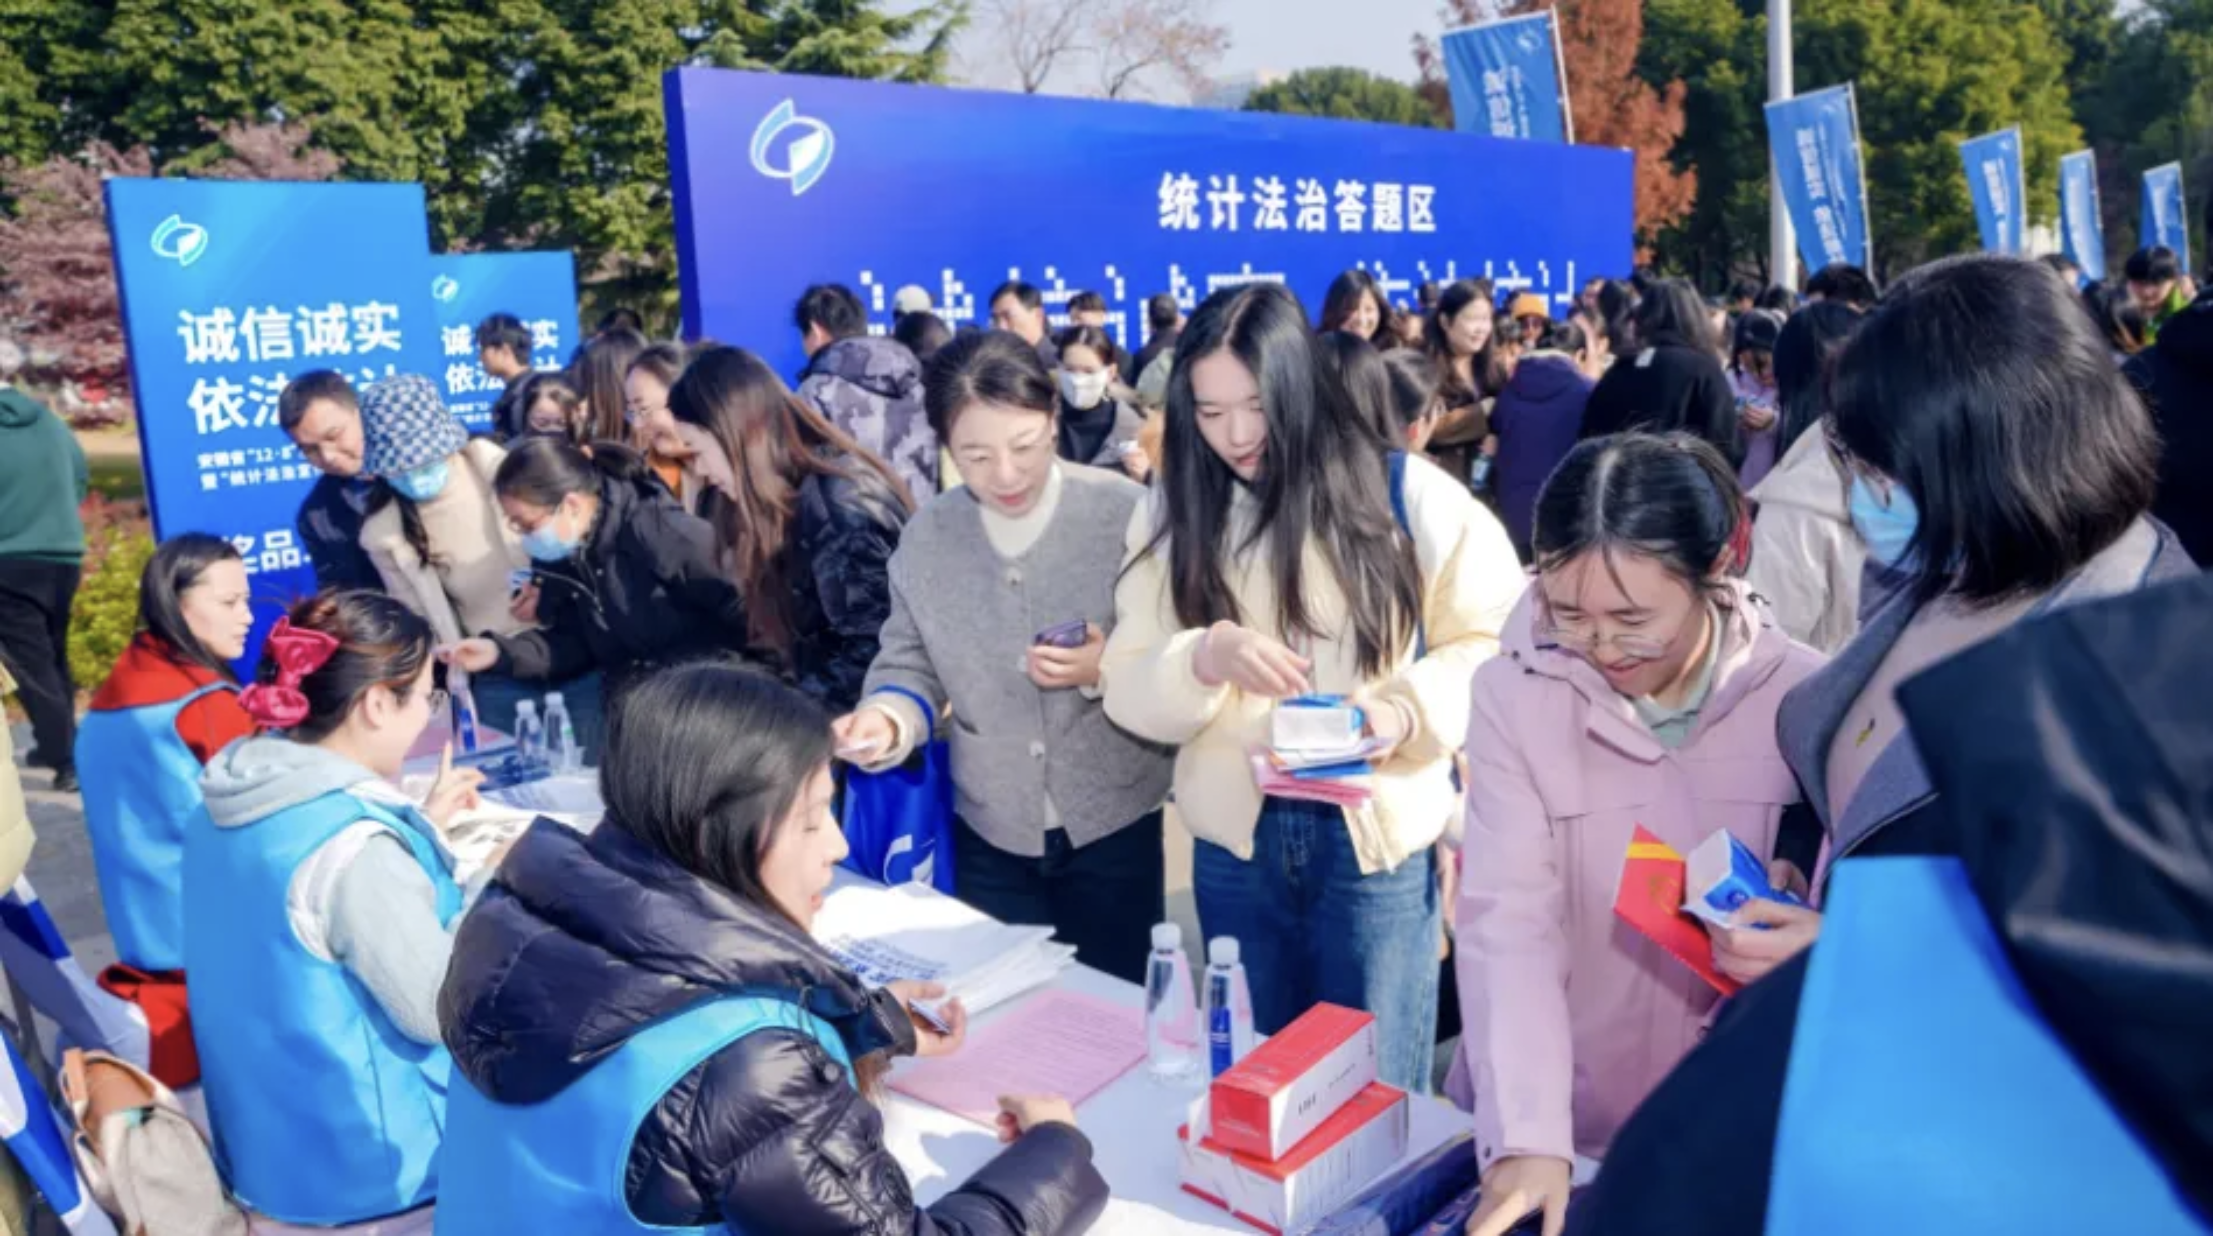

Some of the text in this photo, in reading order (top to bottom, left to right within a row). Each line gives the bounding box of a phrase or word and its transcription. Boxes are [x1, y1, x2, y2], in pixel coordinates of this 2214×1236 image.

[1158, 171, 1437, 232] 统计法治答题区
[177, 301, 402, 364] 诚信诚实
[441, 319, 559, 355] 诚实
